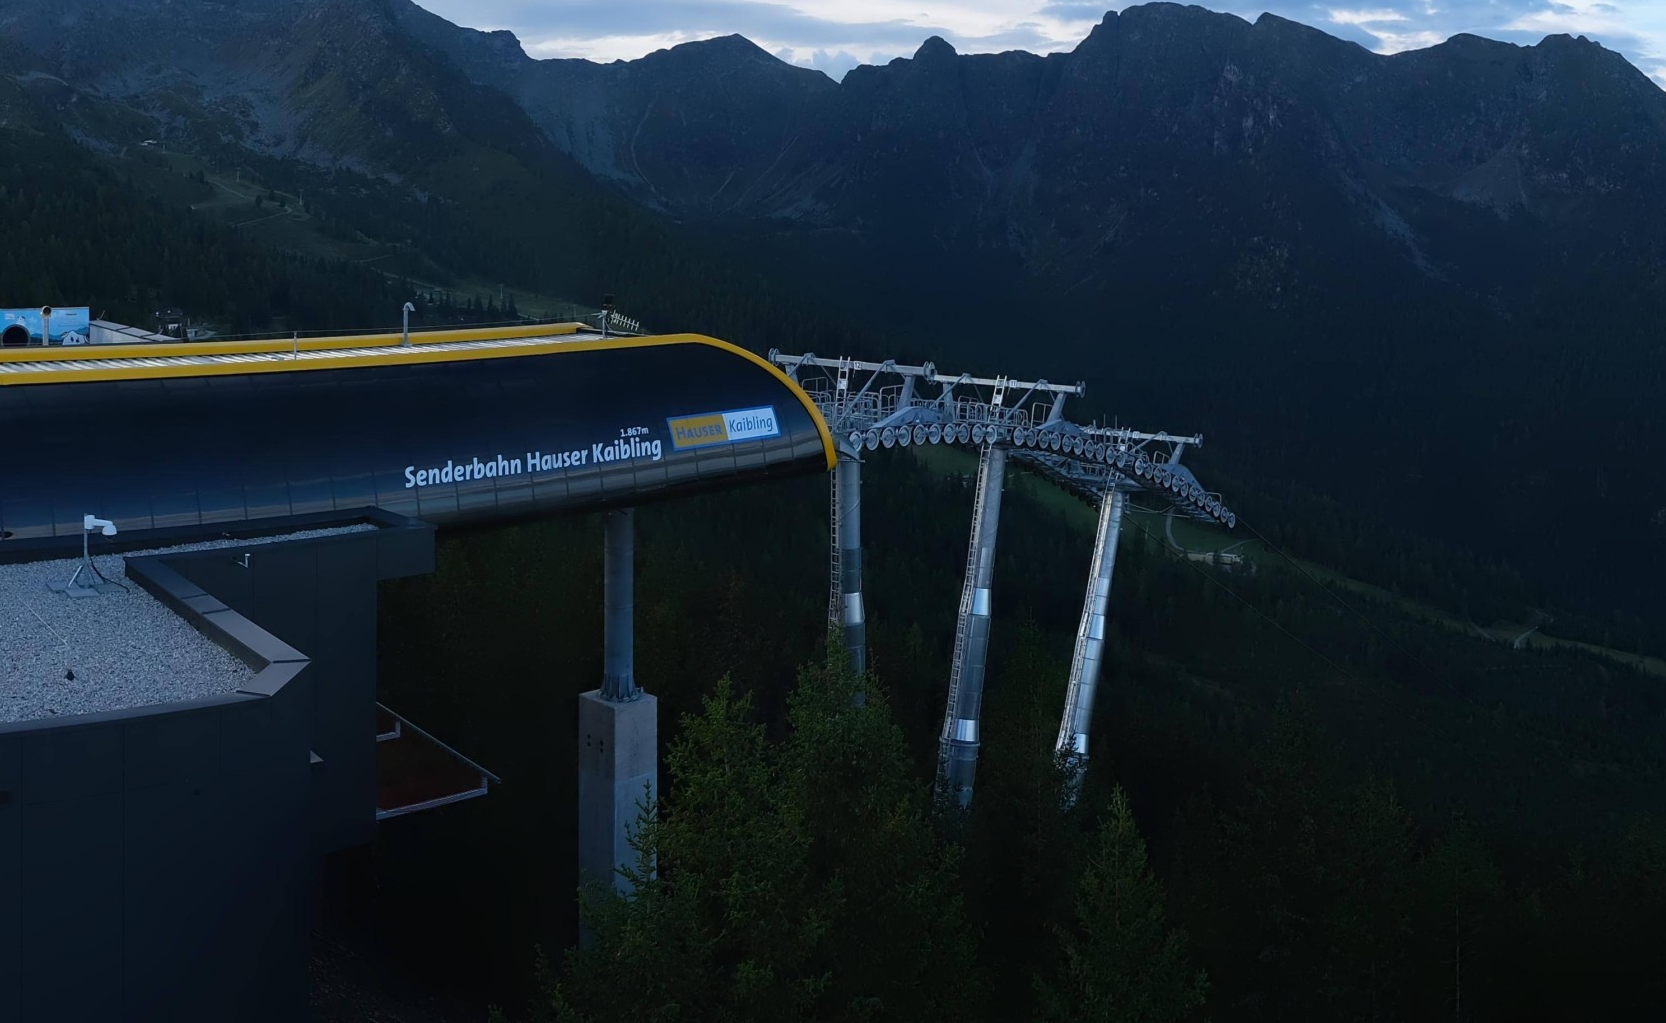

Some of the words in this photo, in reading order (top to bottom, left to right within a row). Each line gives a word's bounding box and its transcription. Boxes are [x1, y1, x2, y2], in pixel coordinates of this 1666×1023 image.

[620, 426, 649, 438] 1.867m
[675, 423, 723, 442] HAUSER
[729, 414, 773, 434] Kaibling
[404, 453, 522, 489] Senderbahn
[527, 444, 588, 473] Hauser
[592, 435, 662, 463] Kaibling
